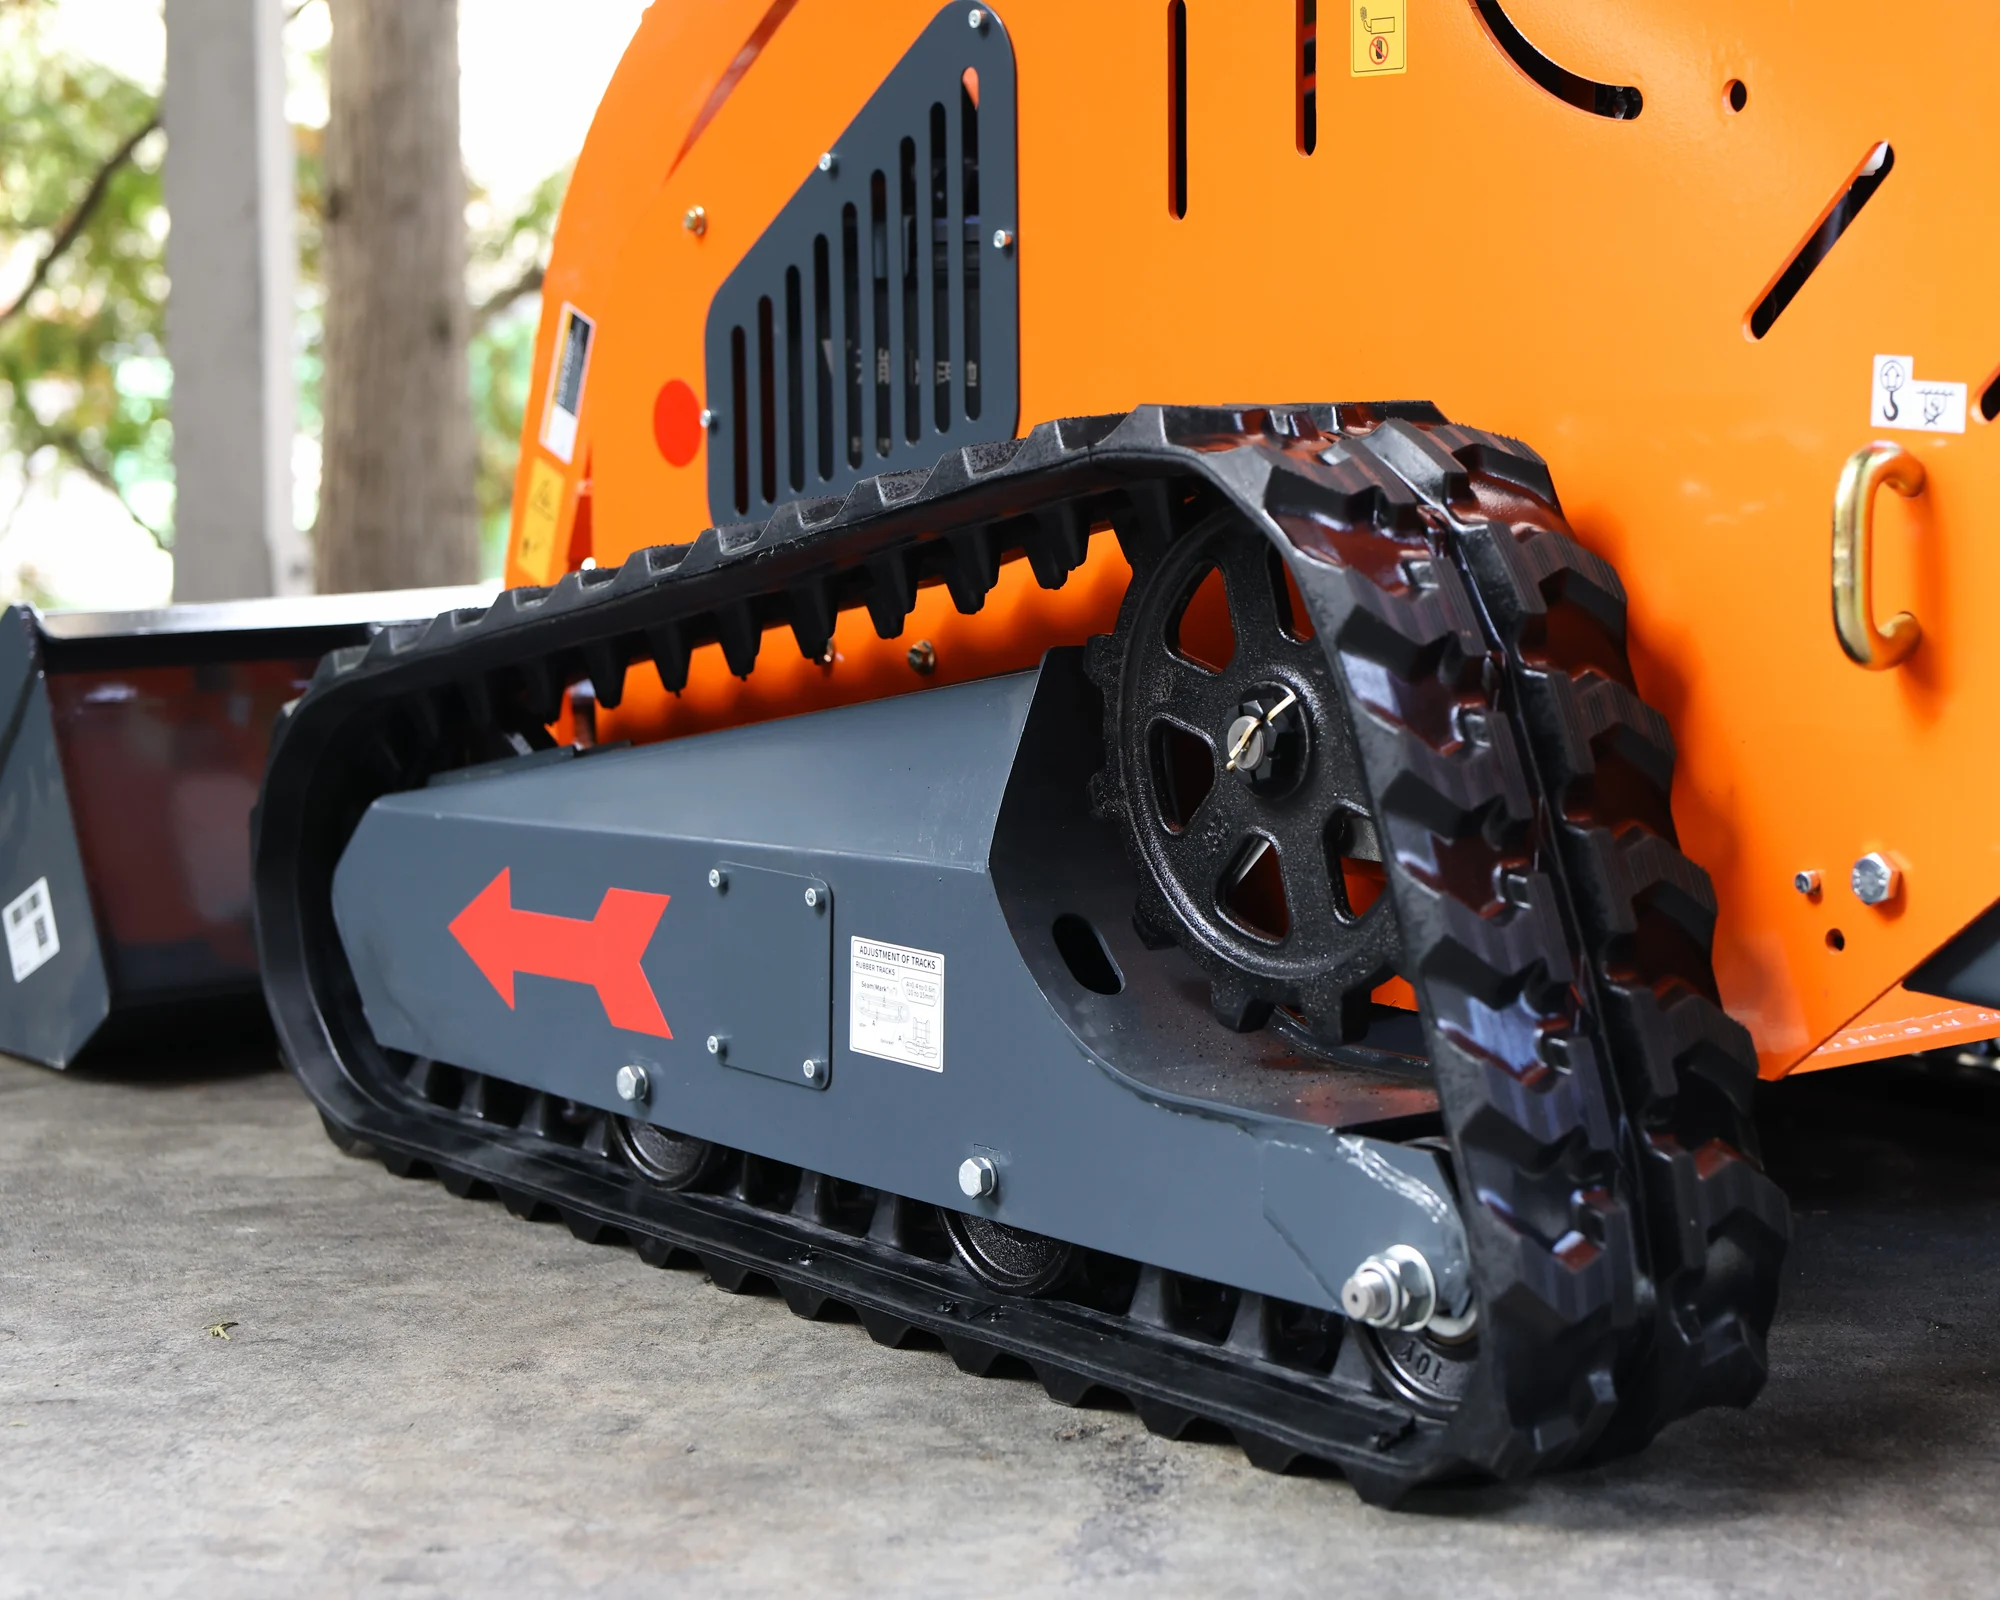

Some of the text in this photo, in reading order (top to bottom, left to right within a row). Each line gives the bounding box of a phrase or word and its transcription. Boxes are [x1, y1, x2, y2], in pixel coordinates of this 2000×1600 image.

[859, 945, 936, 970] ADJUSTMENT OF TRACKS
[856, 960, 896, 976] RUBBER TRACKS
